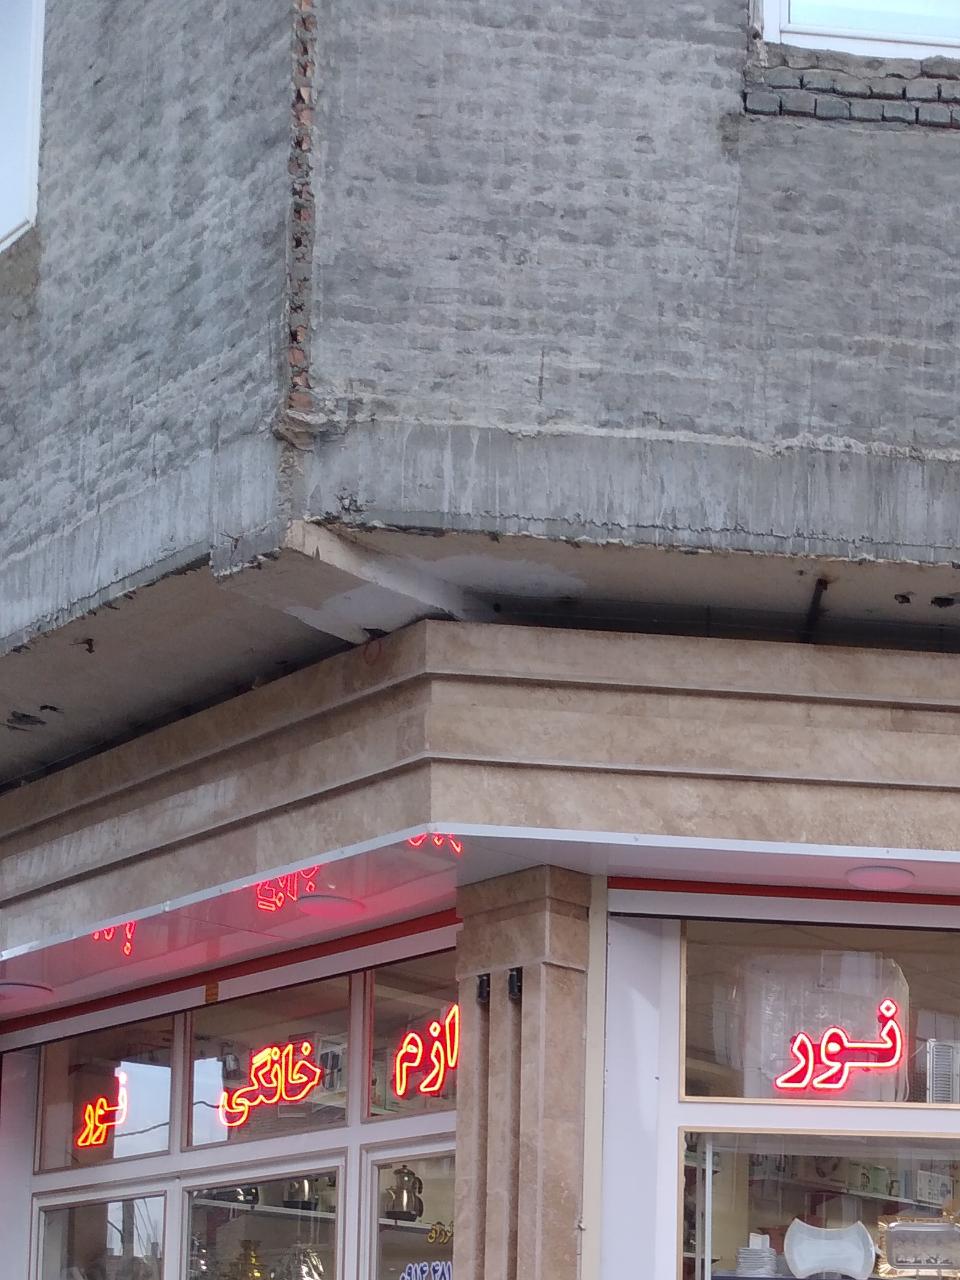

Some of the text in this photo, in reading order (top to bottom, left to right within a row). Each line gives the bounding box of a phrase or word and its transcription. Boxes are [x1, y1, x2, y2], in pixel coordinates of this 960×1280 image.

[76, 1003, 459, 1147] ازم خانگی نور
[776, 998, 902, 1089] نور
